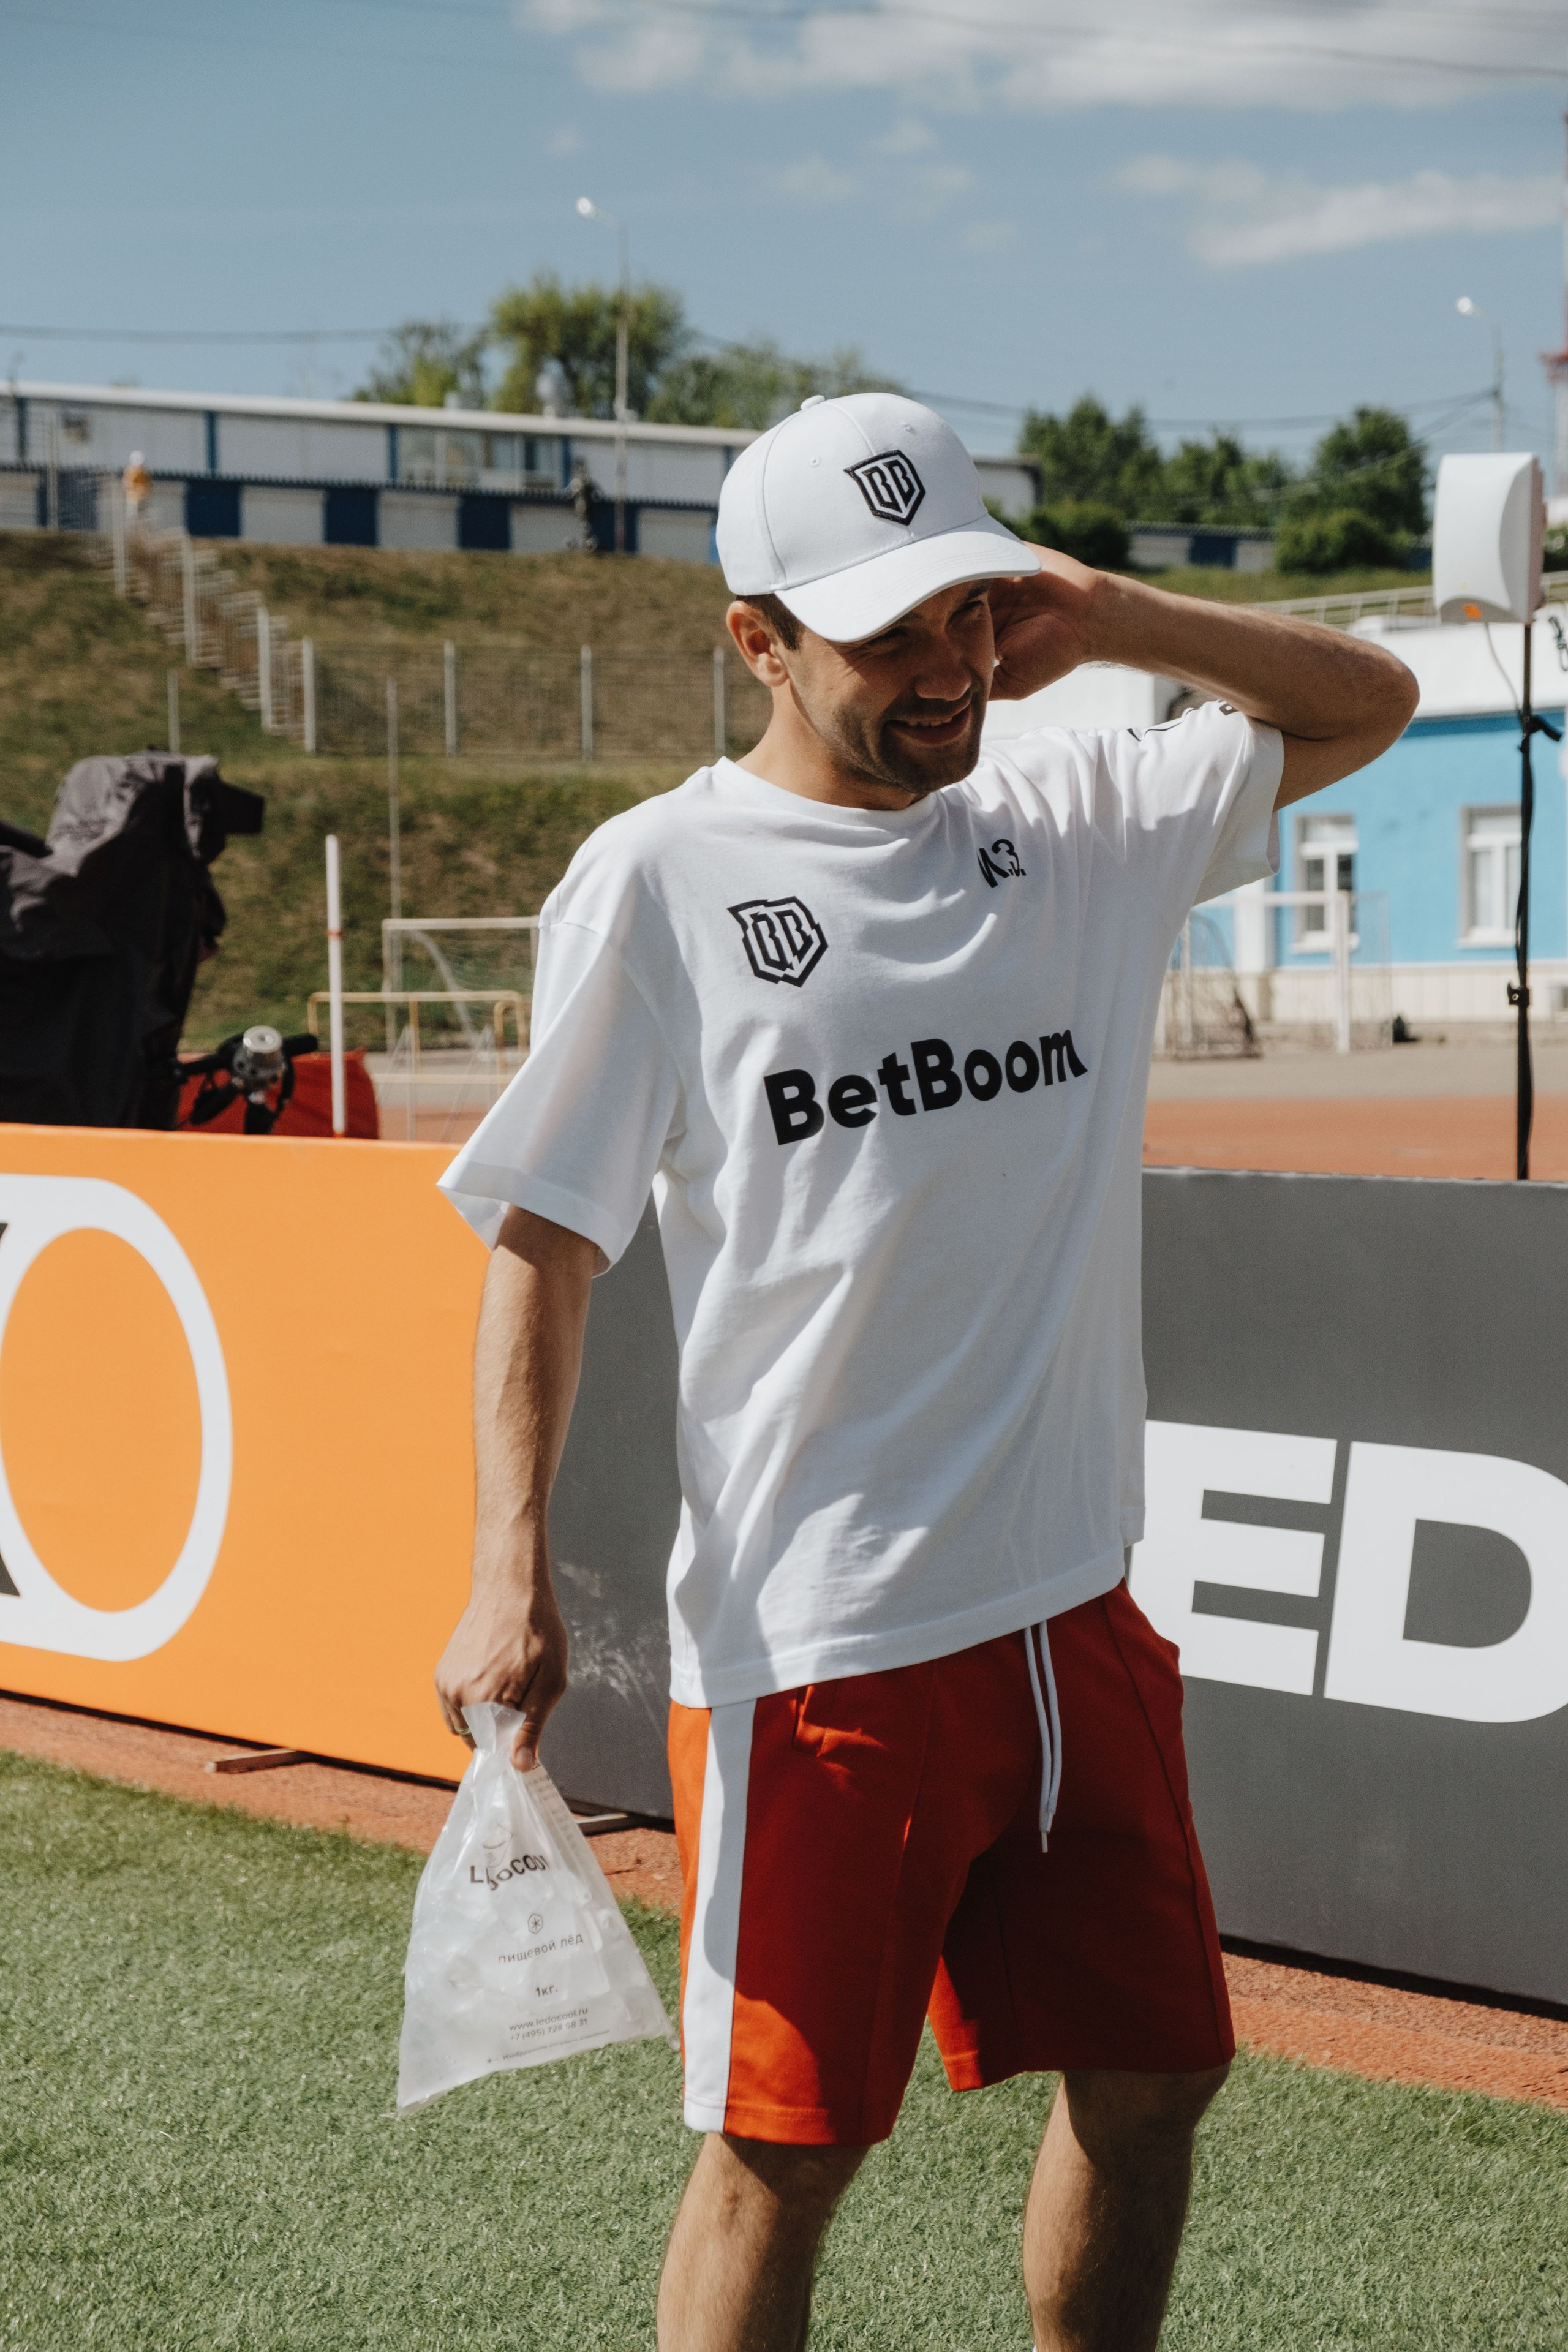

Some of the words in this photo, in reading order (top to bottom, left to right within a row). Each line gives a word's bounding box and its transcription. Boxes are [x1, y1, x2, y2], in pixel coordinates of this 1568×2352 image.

[763, 1029, 1088, 1146] BetBoom
[535, 1985, 558, 1997] 1кг.
[508, 2008, 588, 2032] www.ledocool.ru
[522, 2029, 545, 2040] (495)
[548, 2024, 563, 2034] 728
[565, 2021, 576, 2030] 58
[579, 2018, 587, 2027] 31
